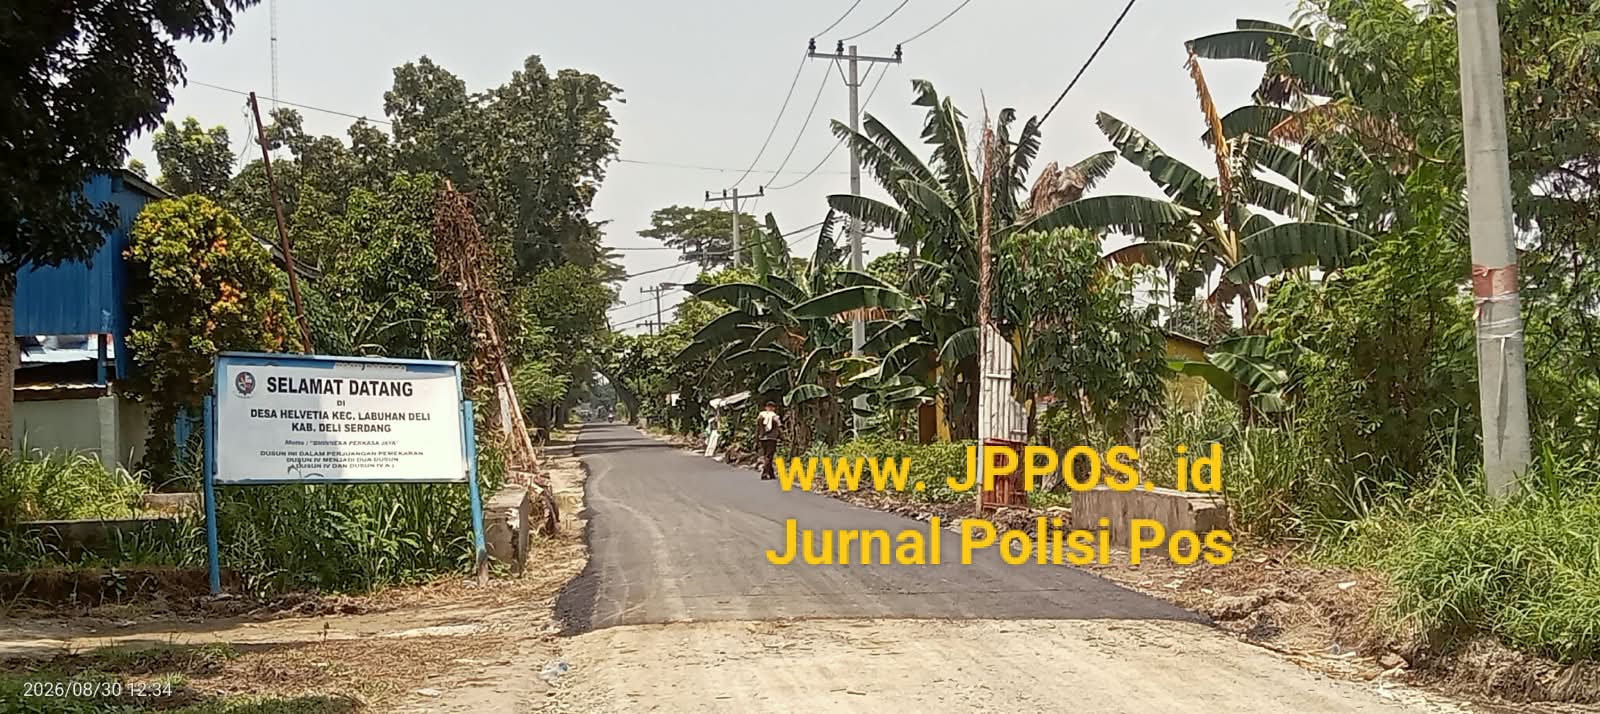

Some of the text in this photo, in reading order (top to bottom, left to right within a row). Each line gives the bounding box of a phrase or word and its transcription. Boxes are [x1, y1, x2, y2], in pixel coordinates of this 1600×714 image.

[266, 376, 414, 397] SELAMAT DATANG
[250, 408, 431, 421] DESA HELVETIA KEC. LABUHAN DELI
[291, 422, 392, 433] KAB. DELI SERDANG
